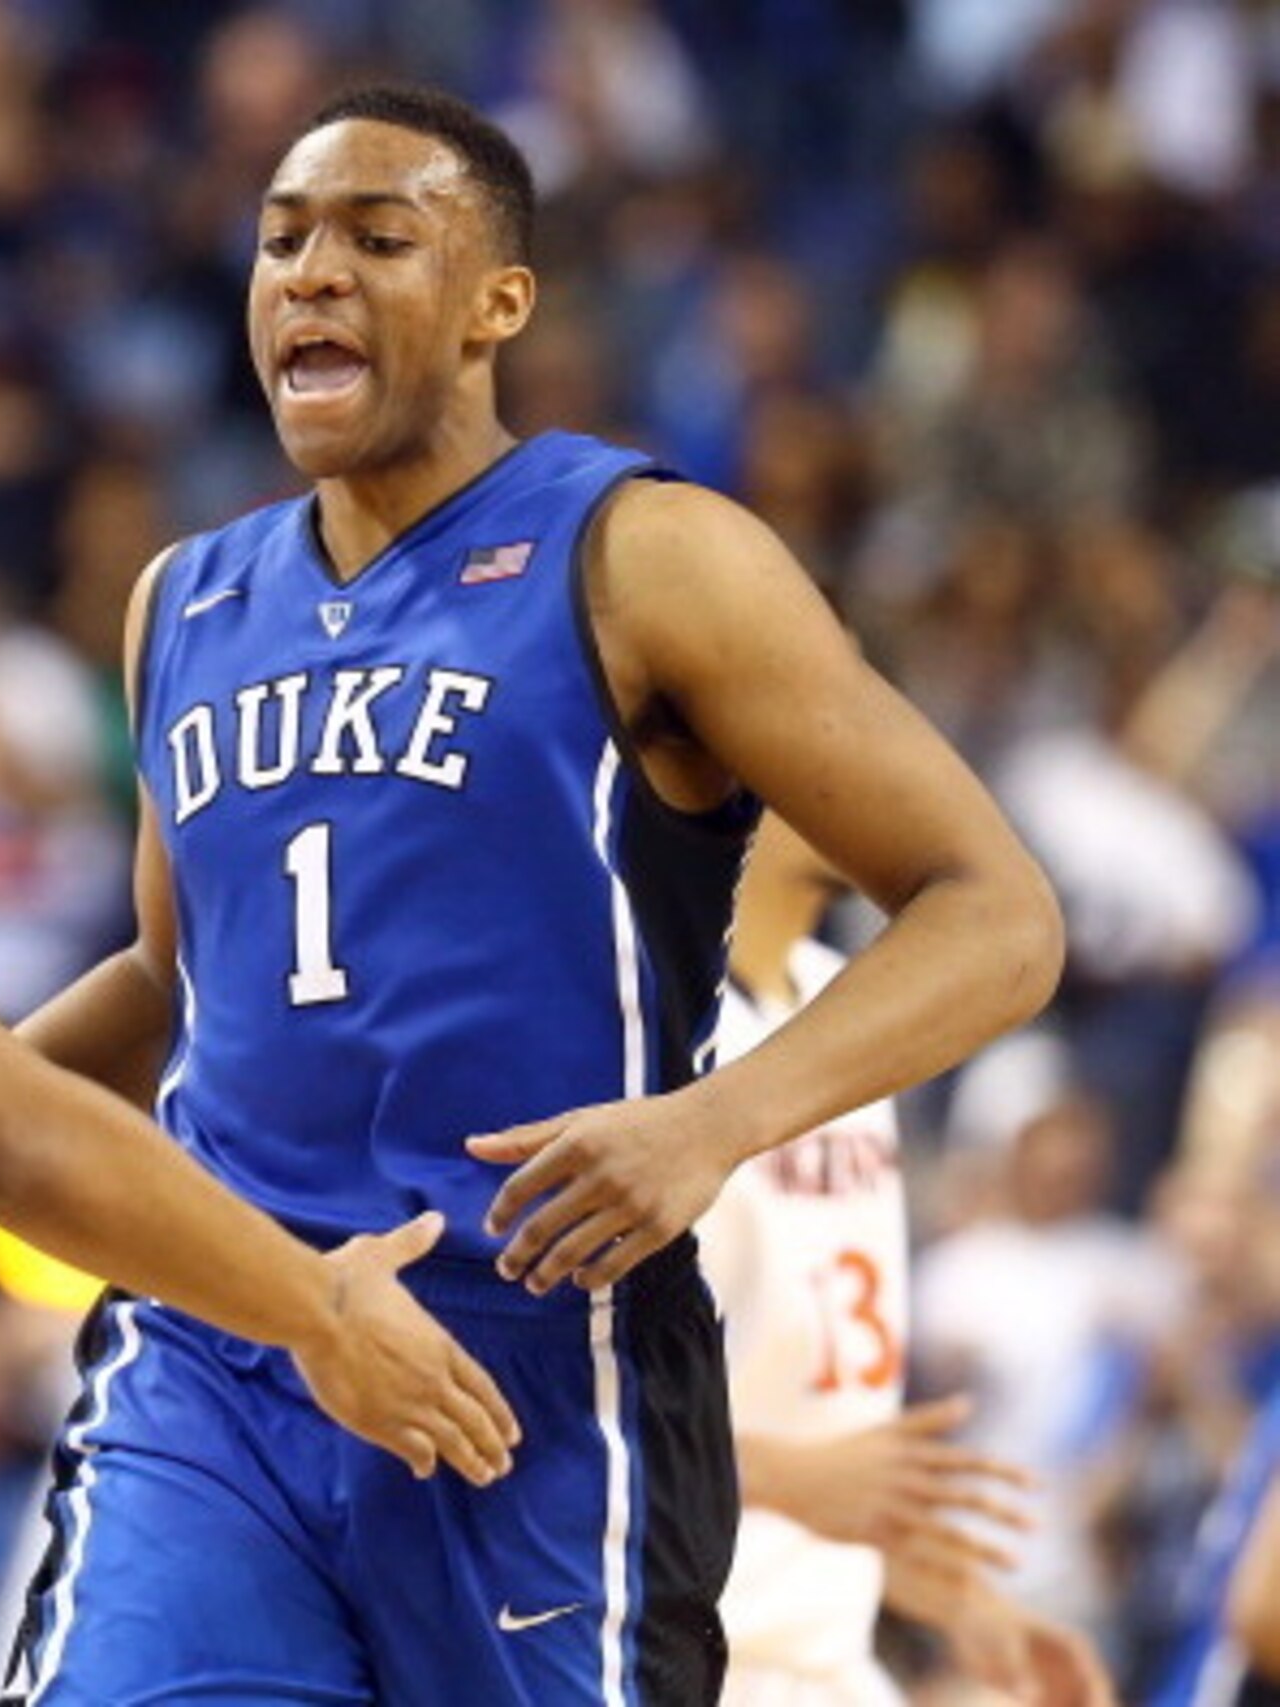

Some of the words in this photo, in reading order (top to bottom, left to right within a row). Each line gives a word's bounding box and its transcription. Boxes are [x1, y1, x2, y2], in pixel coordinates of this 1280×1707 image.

[167, 665, 490, 825] DUKE
[285, 822, 348, 1006] 1
[807, 1249, 903, 1395] 13
